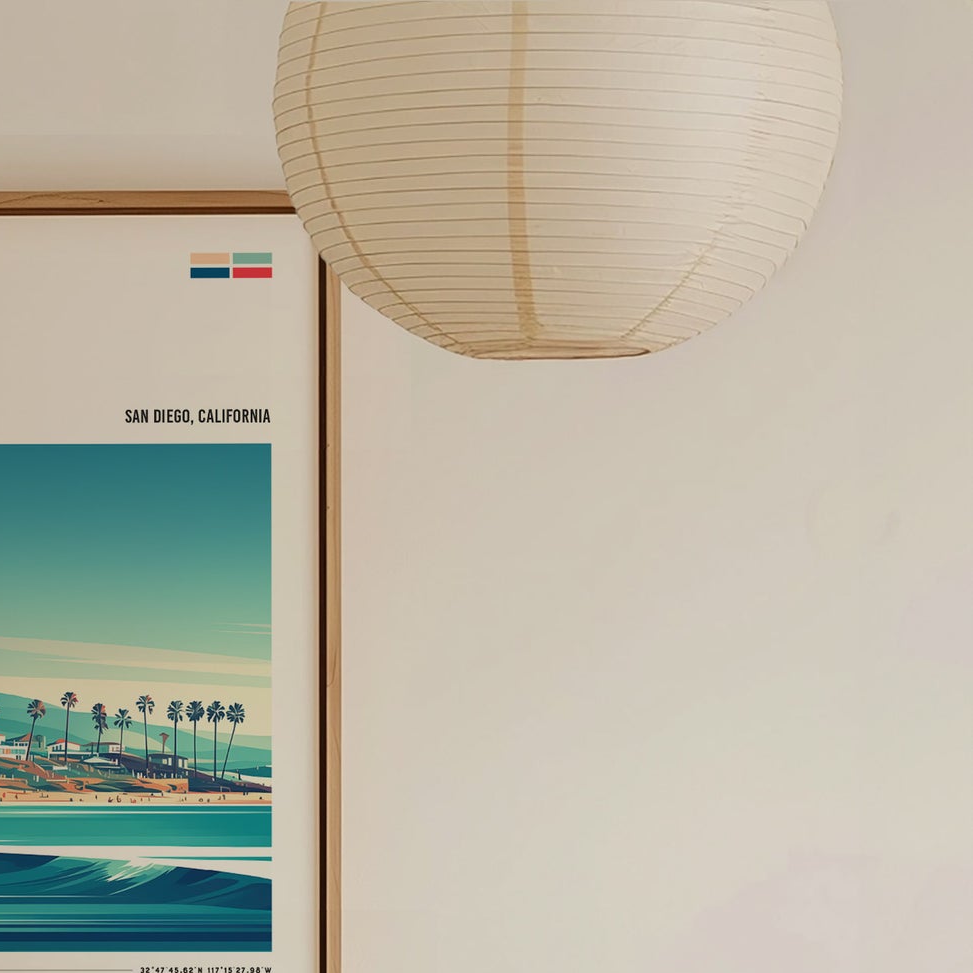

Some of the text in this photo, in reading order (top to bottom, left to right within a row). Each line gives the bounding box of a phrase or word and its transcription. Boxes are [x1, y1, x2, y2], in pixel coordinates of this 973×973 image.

[125, 409, 270, 425] SAN DIEGO, CALIFORNIA
